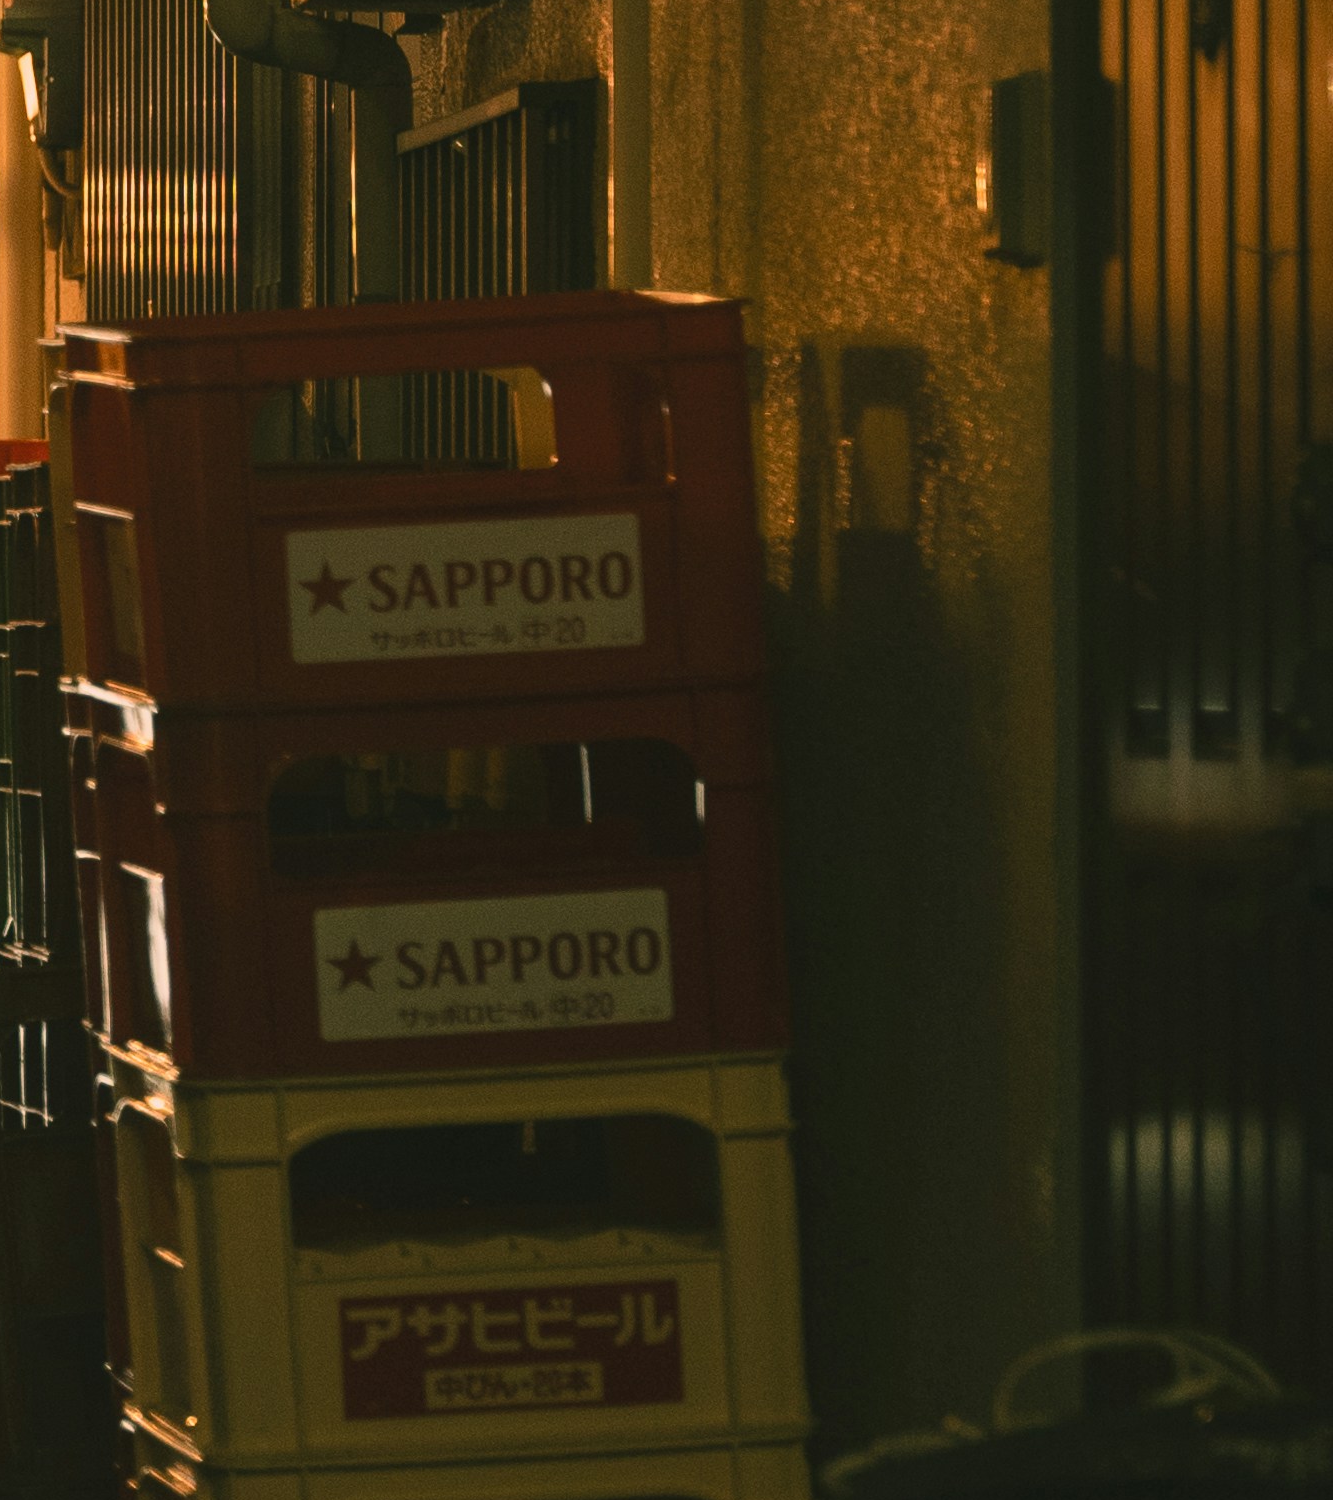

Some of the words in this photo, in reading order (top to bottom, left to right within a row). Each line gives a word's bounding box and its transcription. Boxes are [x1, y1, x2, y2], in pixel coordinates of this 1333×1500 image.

[367, 551, 634, 614] SAPPORO
[396, 927, 662, 991] SAPPORO
[345, 1290, 675, 1362] アサヒビール
